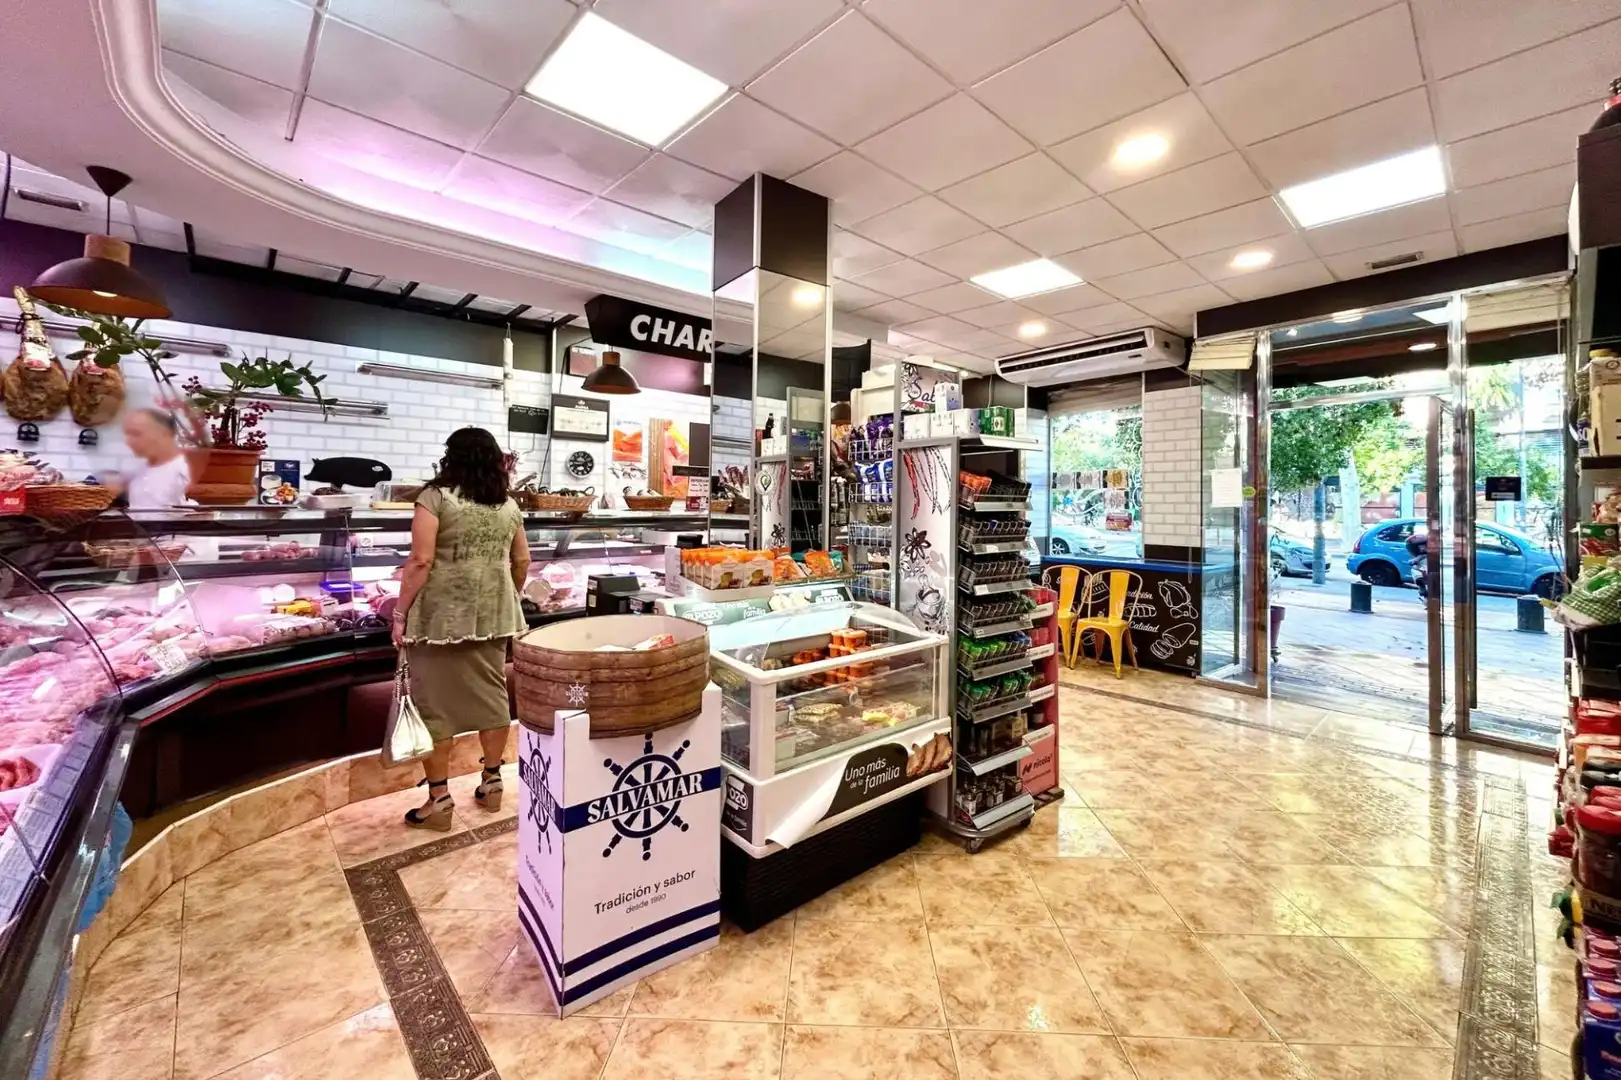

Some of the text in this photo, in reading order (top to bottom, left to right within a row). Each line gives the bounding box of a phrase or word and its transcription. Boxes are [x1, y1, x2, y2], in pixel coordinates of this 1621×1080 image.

[630, 314, 713, 354] CHAR
[1129, 620, 1160, 633] Calidad
[845, 757, 887, 782] Uno más
[863, 765, 901, 795] familia
[587, 772, 703, 824] SALVAMAR
[594, 869, 696, 915] Tradición y sabor
[625, 902, 649, 914] desde
